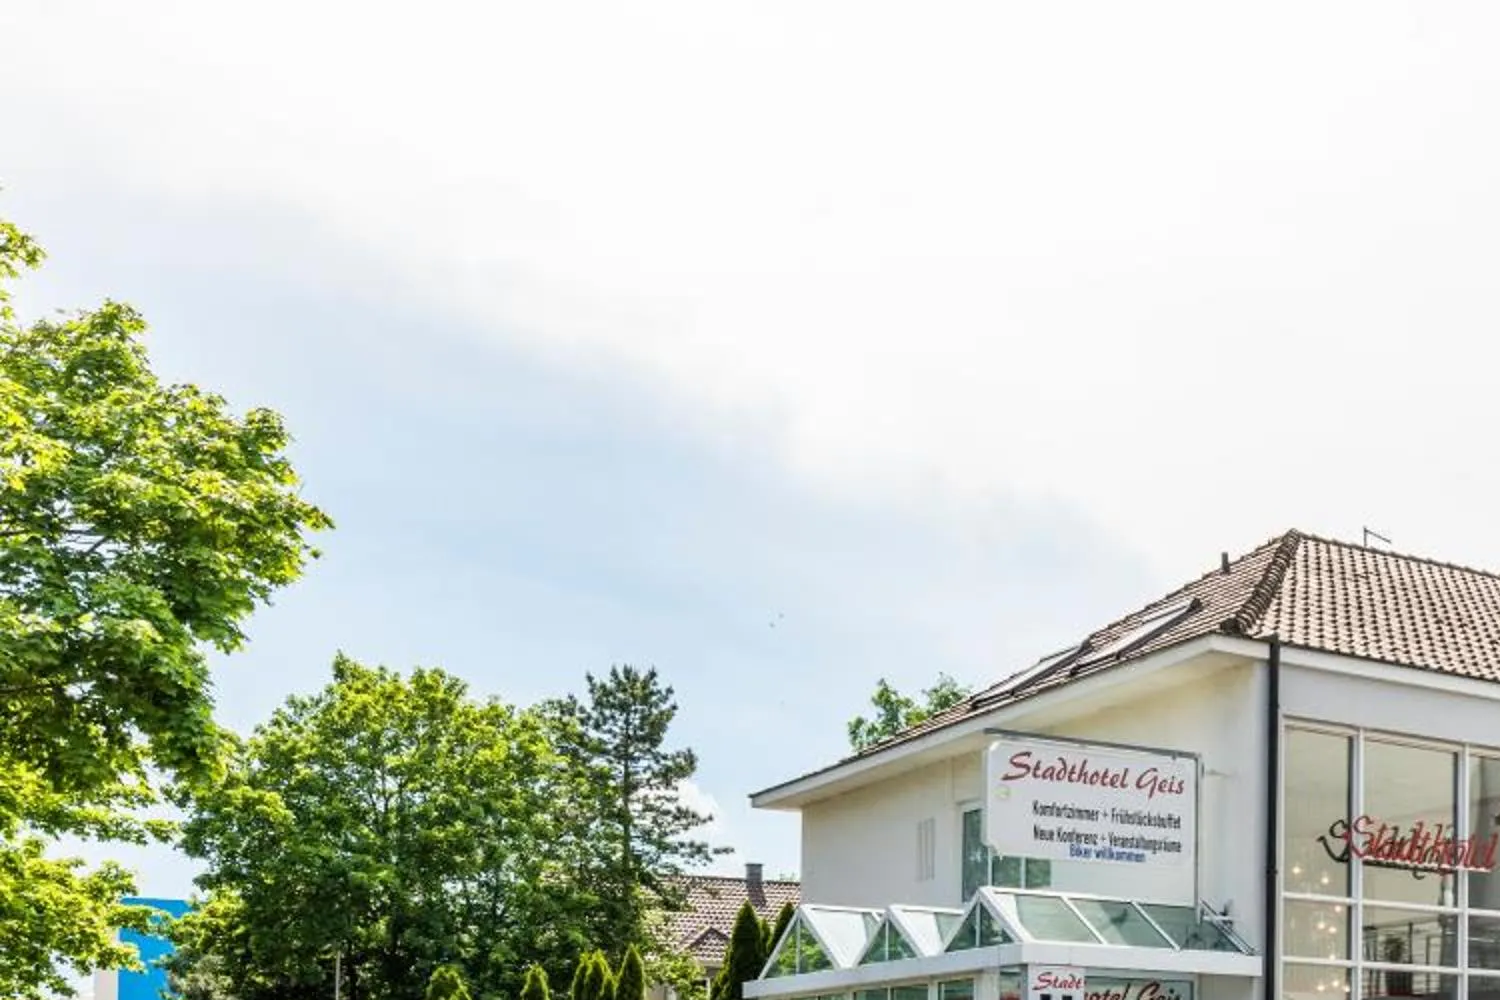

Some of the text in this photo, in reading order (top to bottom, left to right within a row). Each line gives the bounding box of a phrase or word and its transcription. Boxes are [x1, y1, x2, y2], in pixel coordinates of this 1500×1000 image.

[1001, 751, 1185, 798] Stadthotel Geis
[1032, 800, 1098, 821] Komfortzimmer
[1033, 824, 1055, 841] Neue
[1032, 971, 1083, 991] Stadt
